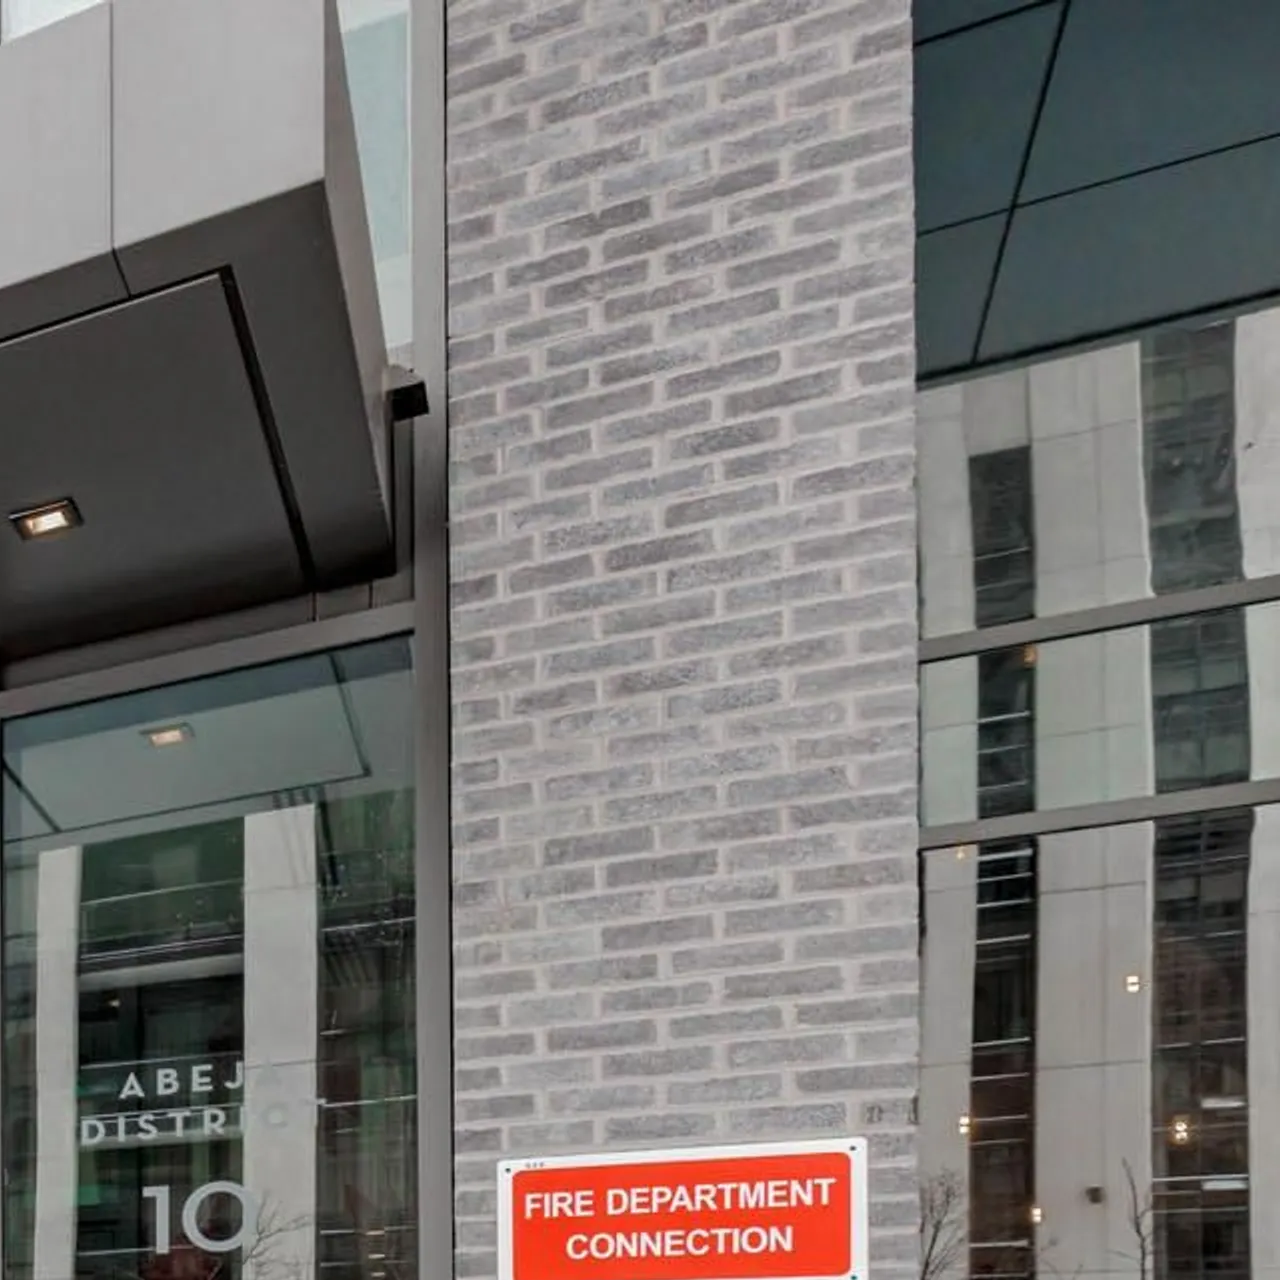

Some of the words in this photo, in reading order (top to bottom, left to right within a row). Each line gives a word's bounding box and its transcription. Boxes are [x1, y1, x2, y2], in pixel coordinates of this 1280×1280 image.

[142, 1180, 258, 1255] 10
[524, 1190, 594, 1219] FIRE
[606, 1178, 836, 1216] DEPARTMENT
[566, 1226, 794, 1260] CONNECTION
